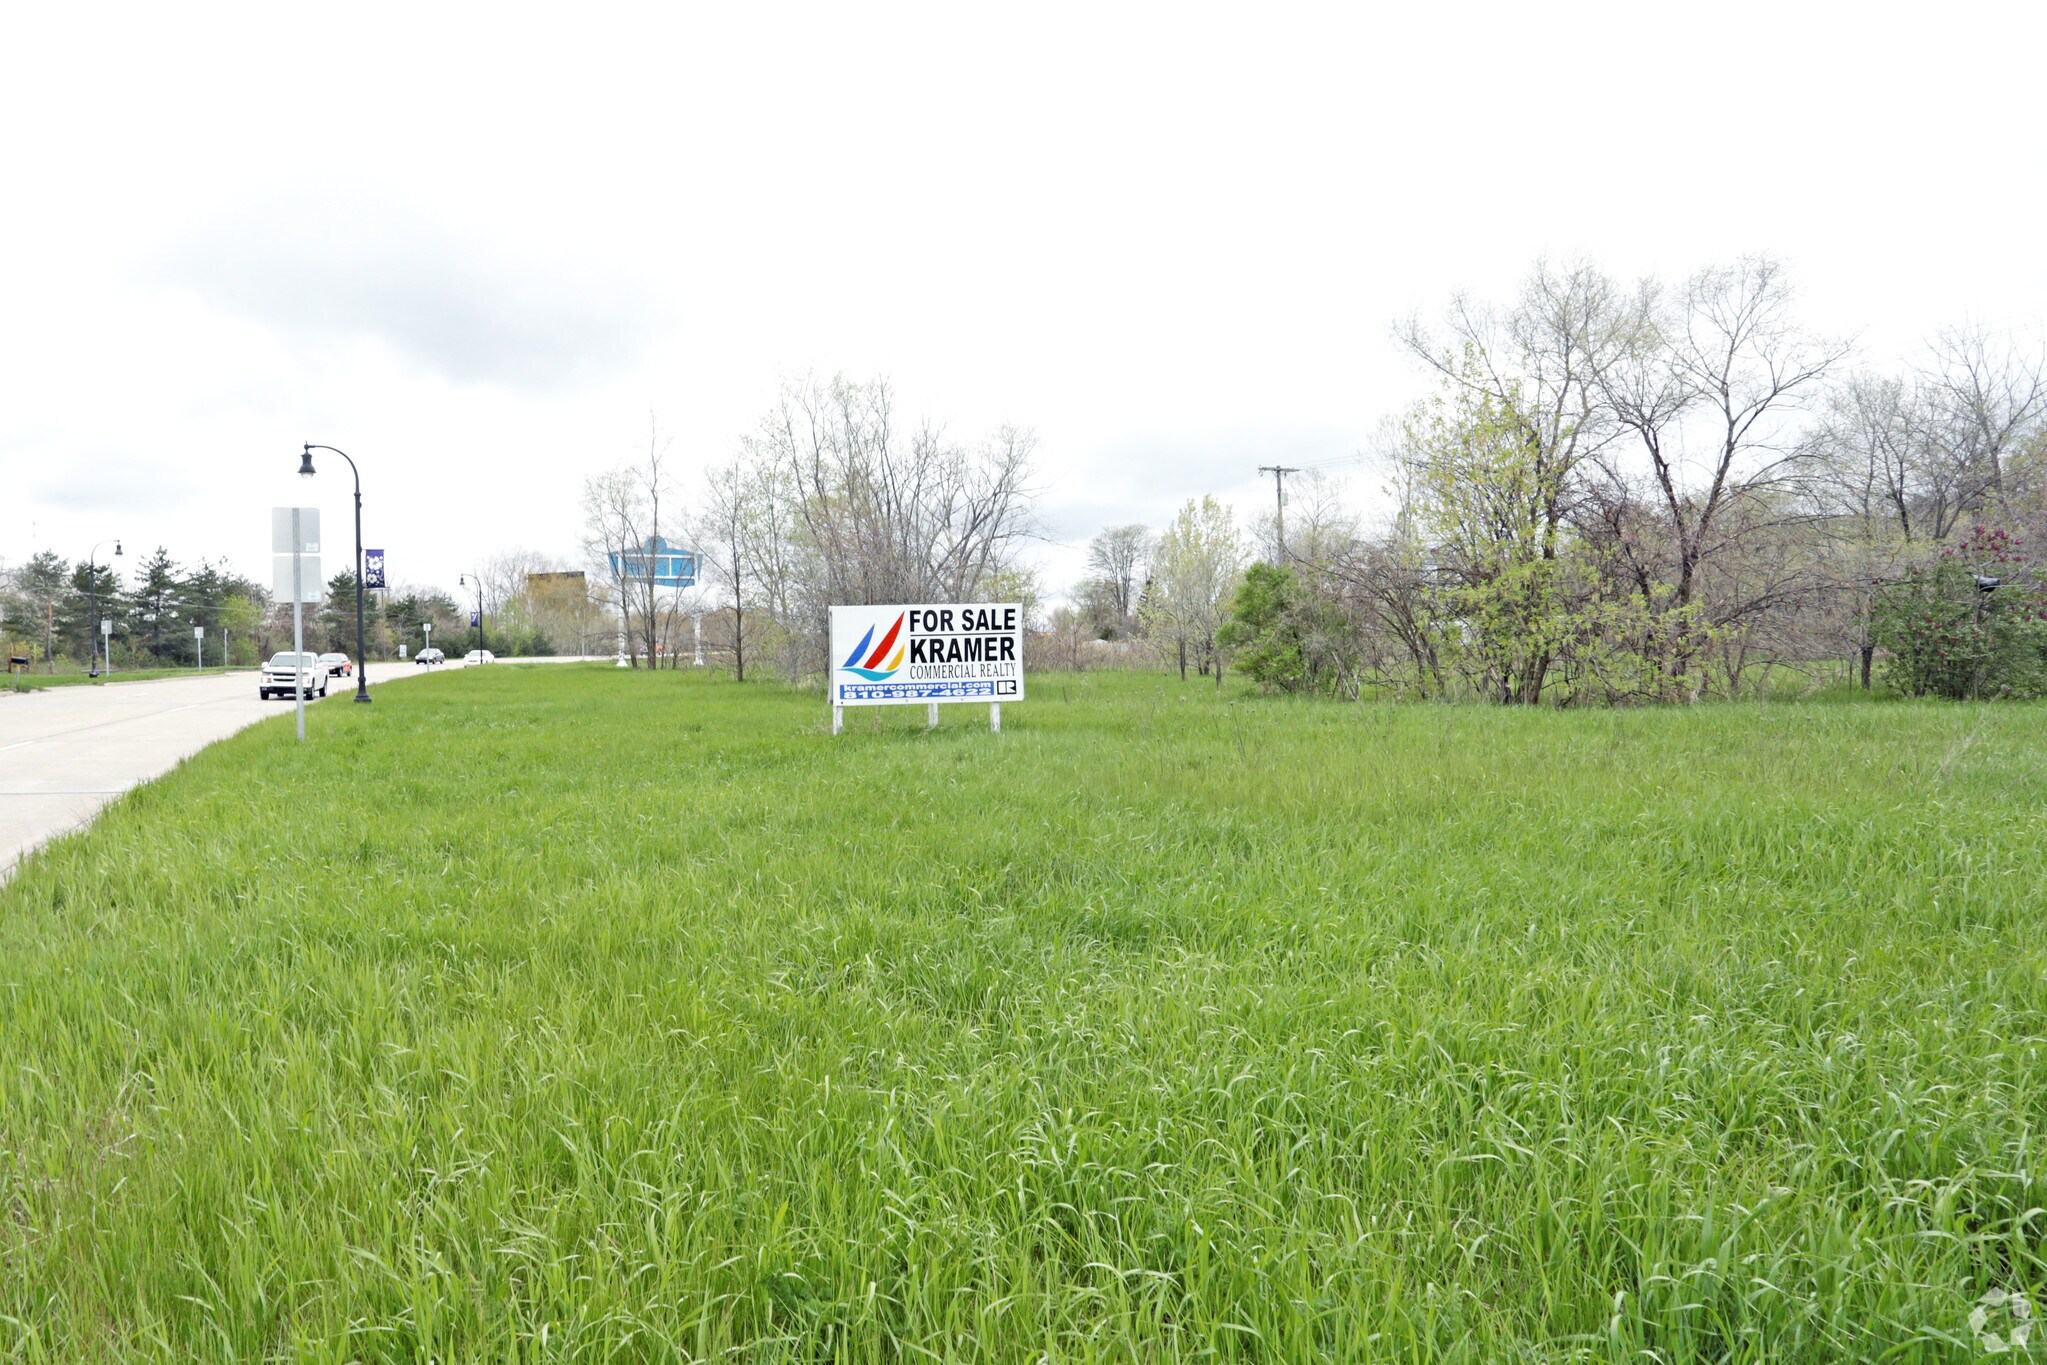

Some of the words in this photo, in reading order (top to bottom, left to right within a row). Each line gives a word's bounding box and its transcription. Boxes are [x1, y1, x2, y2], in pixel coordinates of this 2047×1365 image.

[909, 609, 954, 632] FOR
[961, 608, 1016, 631] SALE
[910, 637, 1015, 663] KRAMER
[910, 664, 977, 679] COMMERCIAL
[980, 663, 1016, 677] REALTY
[843, 682, 991, 692] kramercommercial.com
[843, 689, 992, 699] 810-987-4622
